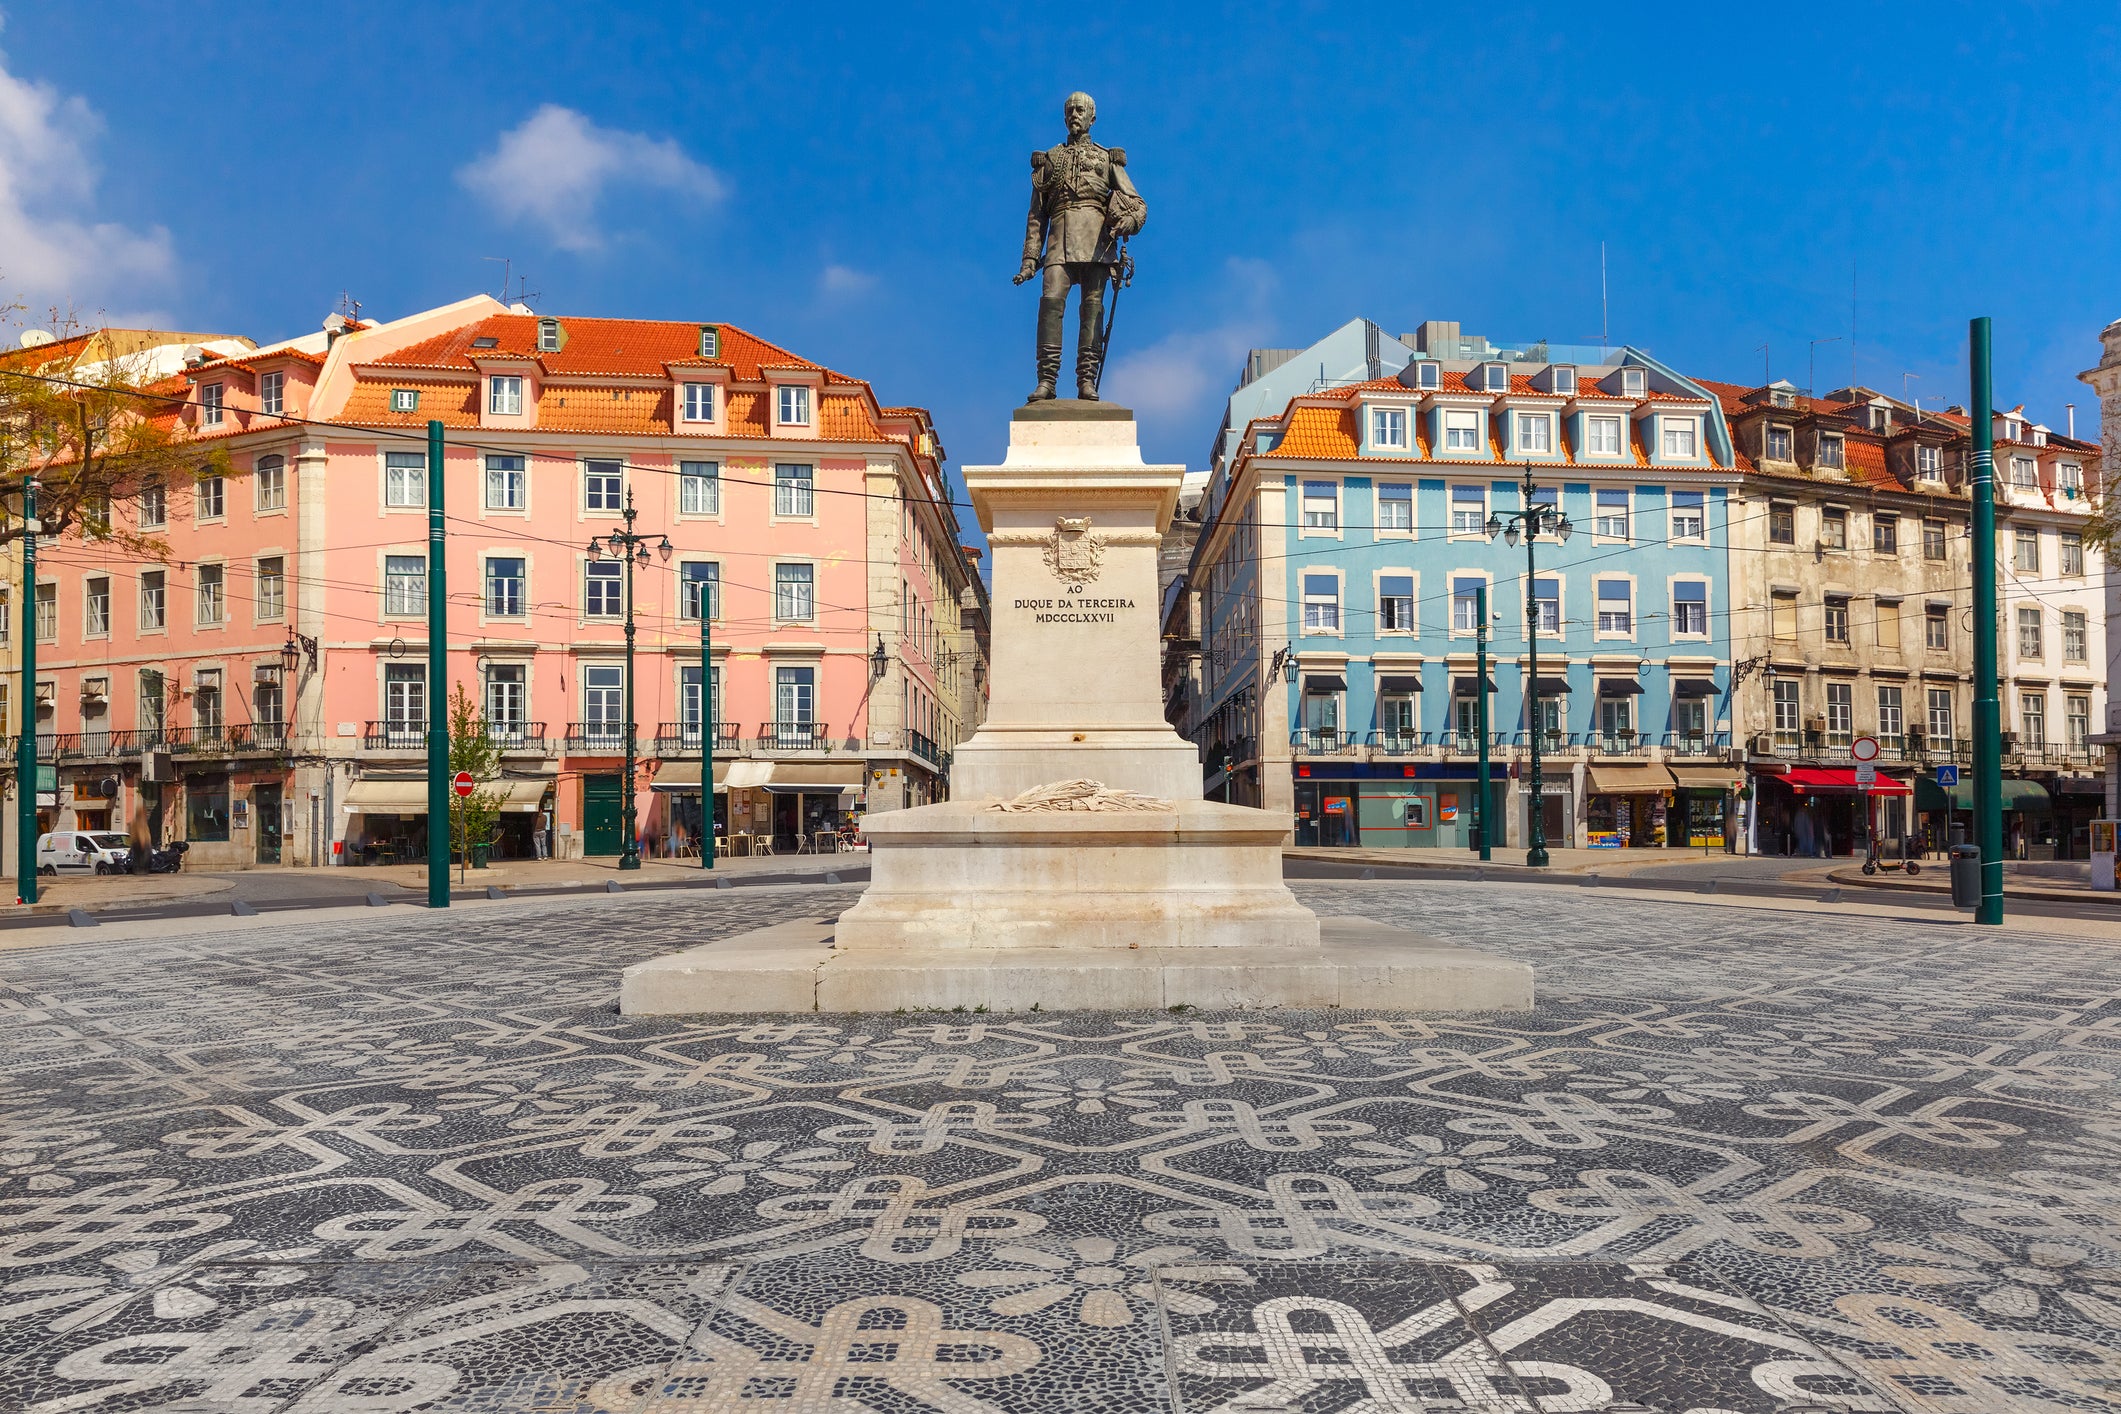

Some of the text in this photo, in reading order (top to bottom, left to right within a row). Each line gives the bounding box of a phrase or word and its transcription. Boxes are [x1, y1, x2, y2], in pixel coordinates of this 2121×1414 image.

[1067, 585, 1083, 594] AO
[1014, 599, 1135, 610] DUQUE DA TERCEIRA
[1036, 613, 1114, 623] MDCCCLXXVII
